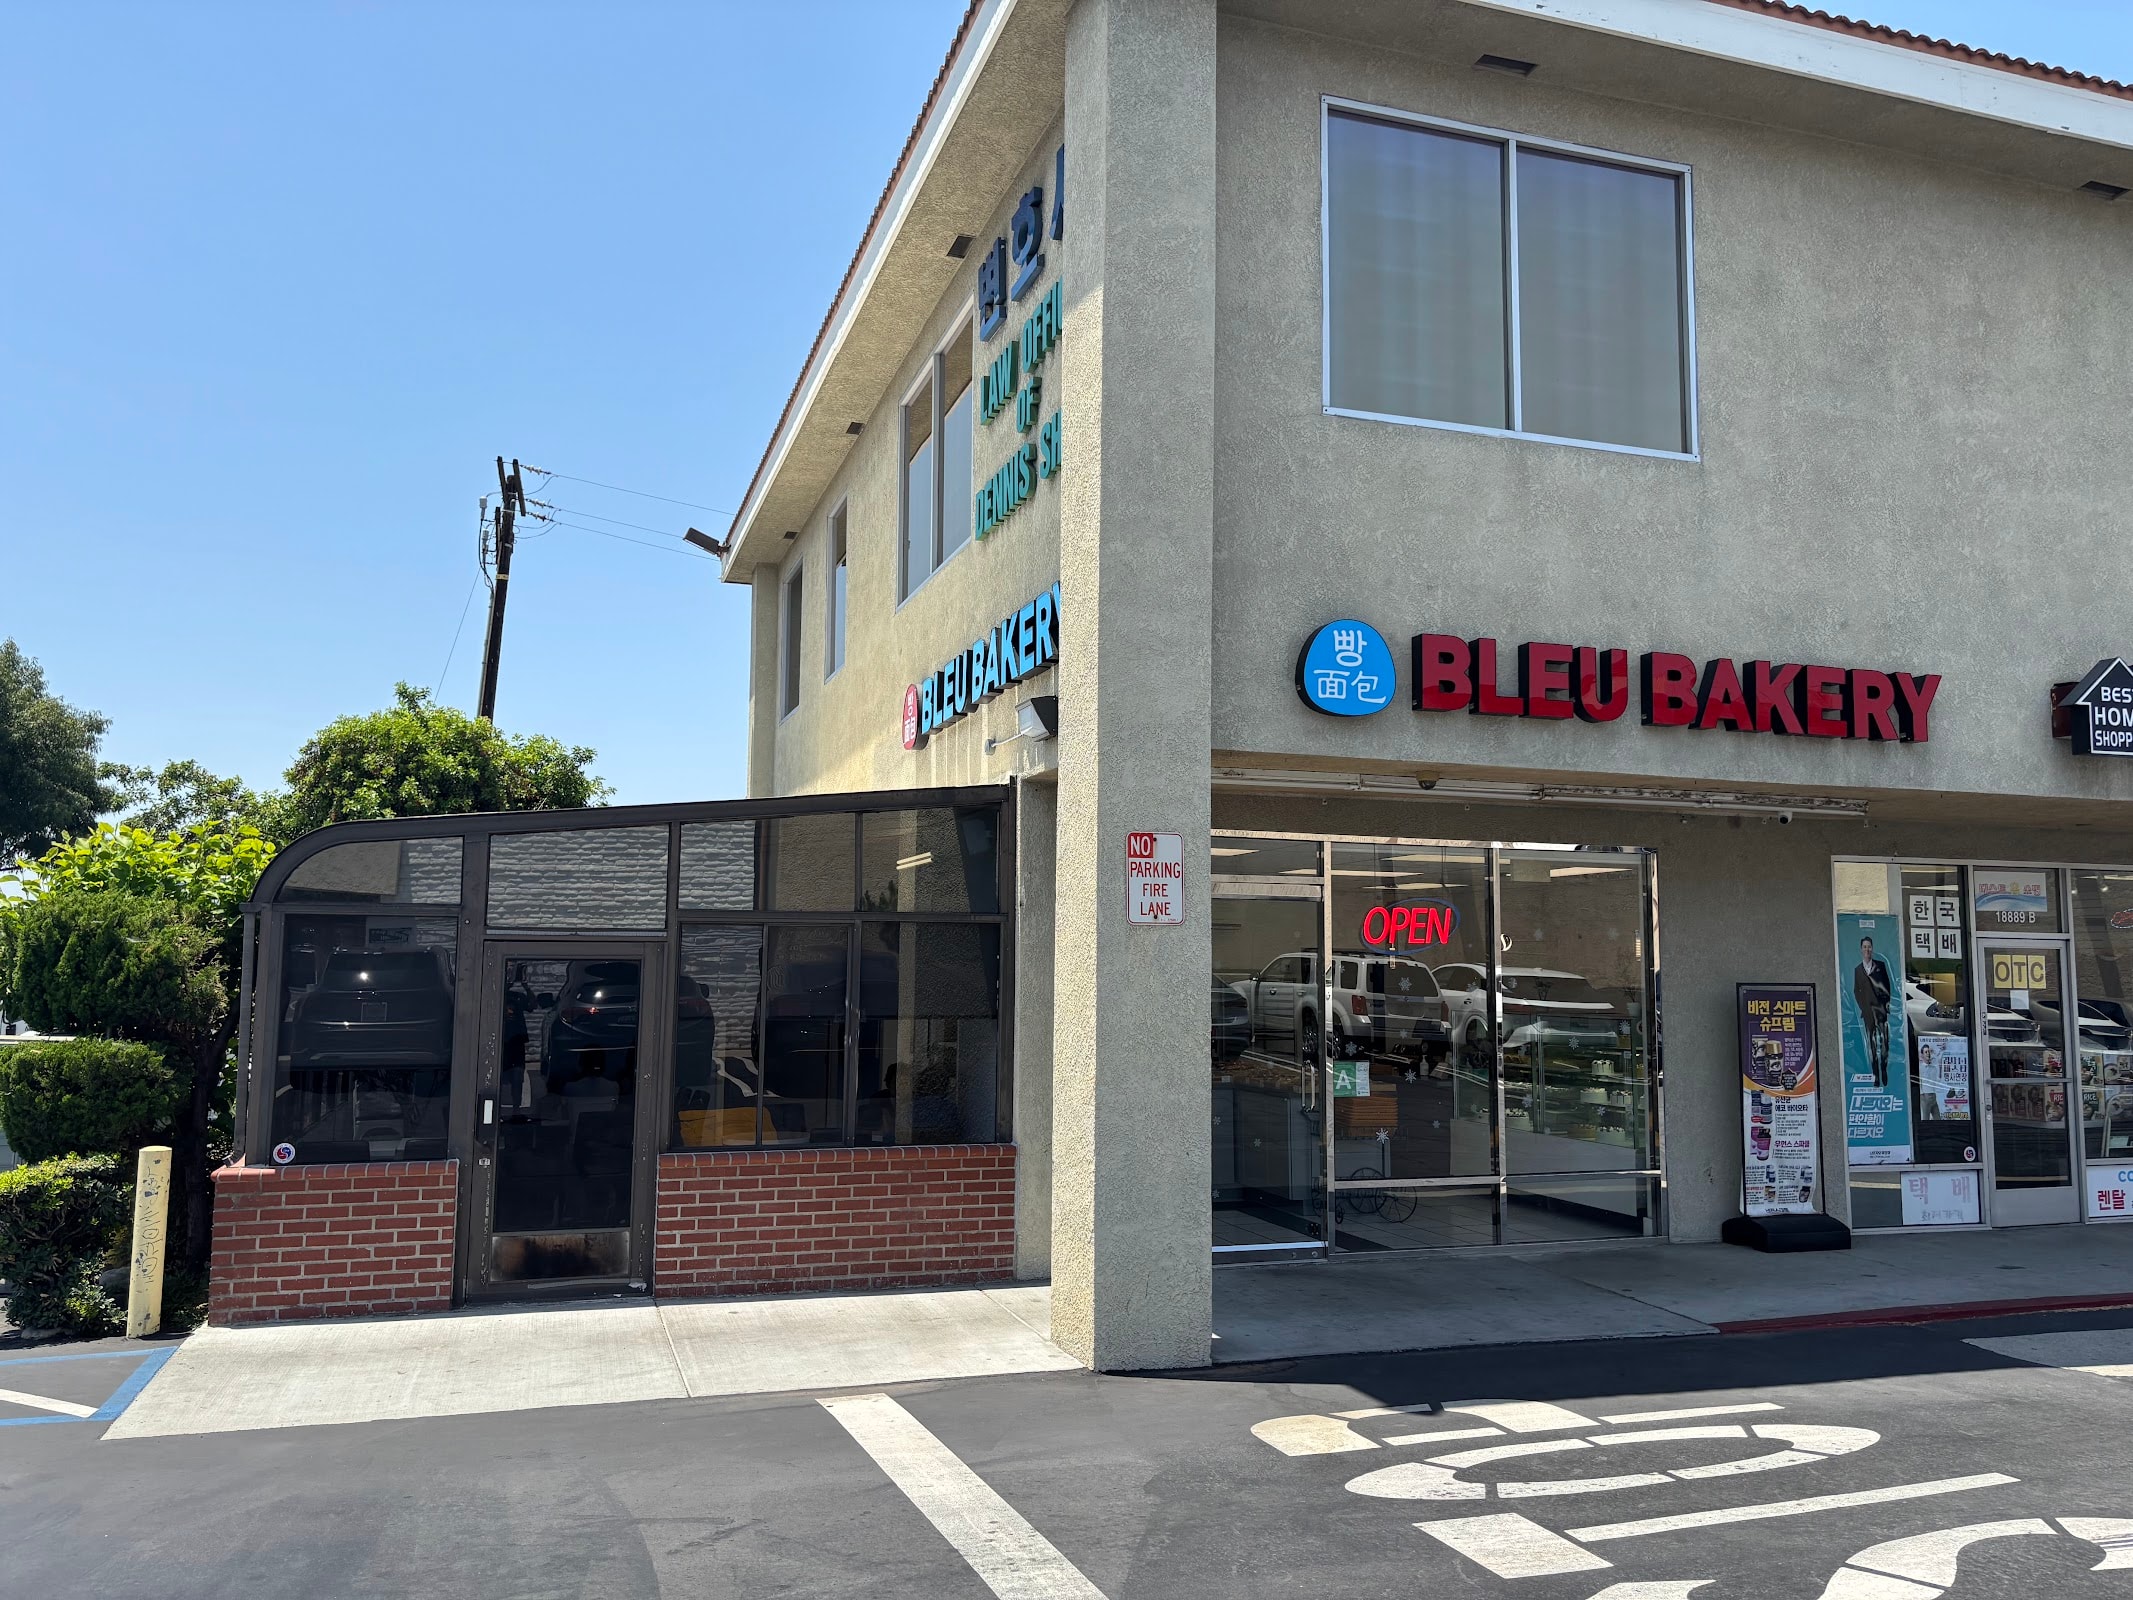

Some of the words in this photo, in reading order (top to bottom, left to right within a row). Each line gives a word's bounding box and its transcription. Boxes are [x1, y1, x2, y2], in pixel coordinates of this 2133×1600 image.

[981, 341, 1018, 425] LAW
[1017, 377, 1041, 433] OF
[976, 442, 1036, 541] DENNIS
[1333, 629, 1368, 667] 빵
[921, 651, 970, 735] BLEU
[1313, 670, 1387, 704] 面包
[1412, 633, 1629, 723] BLEU
[1641, 650, 1941, 743] BAKERY
[2101, 686, 2133, 703] BES
[1130, 835, 1151, 856] NO
[1130, 861, 1181, 878] PARKING
[1142, 883, 1168, 897] FIRE
[1140, 901, 1171, 916] LANE
[1913, 900, 1956, 922] 한국
[1995, 911, 2026, 923] 18889
[2028, 911, 2036, 923] B
[1363, 906, 1452, 944] OPEN
[1915, 933, 1957, 954] 택배
[1994, 961, 2044, 982] OTC
[1747, 1000, 1770, 1015] 비전
[1773, 1000, 1806, 1015] 스마트
[1760, 1017, 1796, 1031] 슈프림
[1335, 1070, 1352, 1089] A
[1849, 1113, 1885, 1126] 편안함이
[1848, 1127, 1884, 1139] 다르지오
[2097, 1189, 2126, 1210] 렌탈
